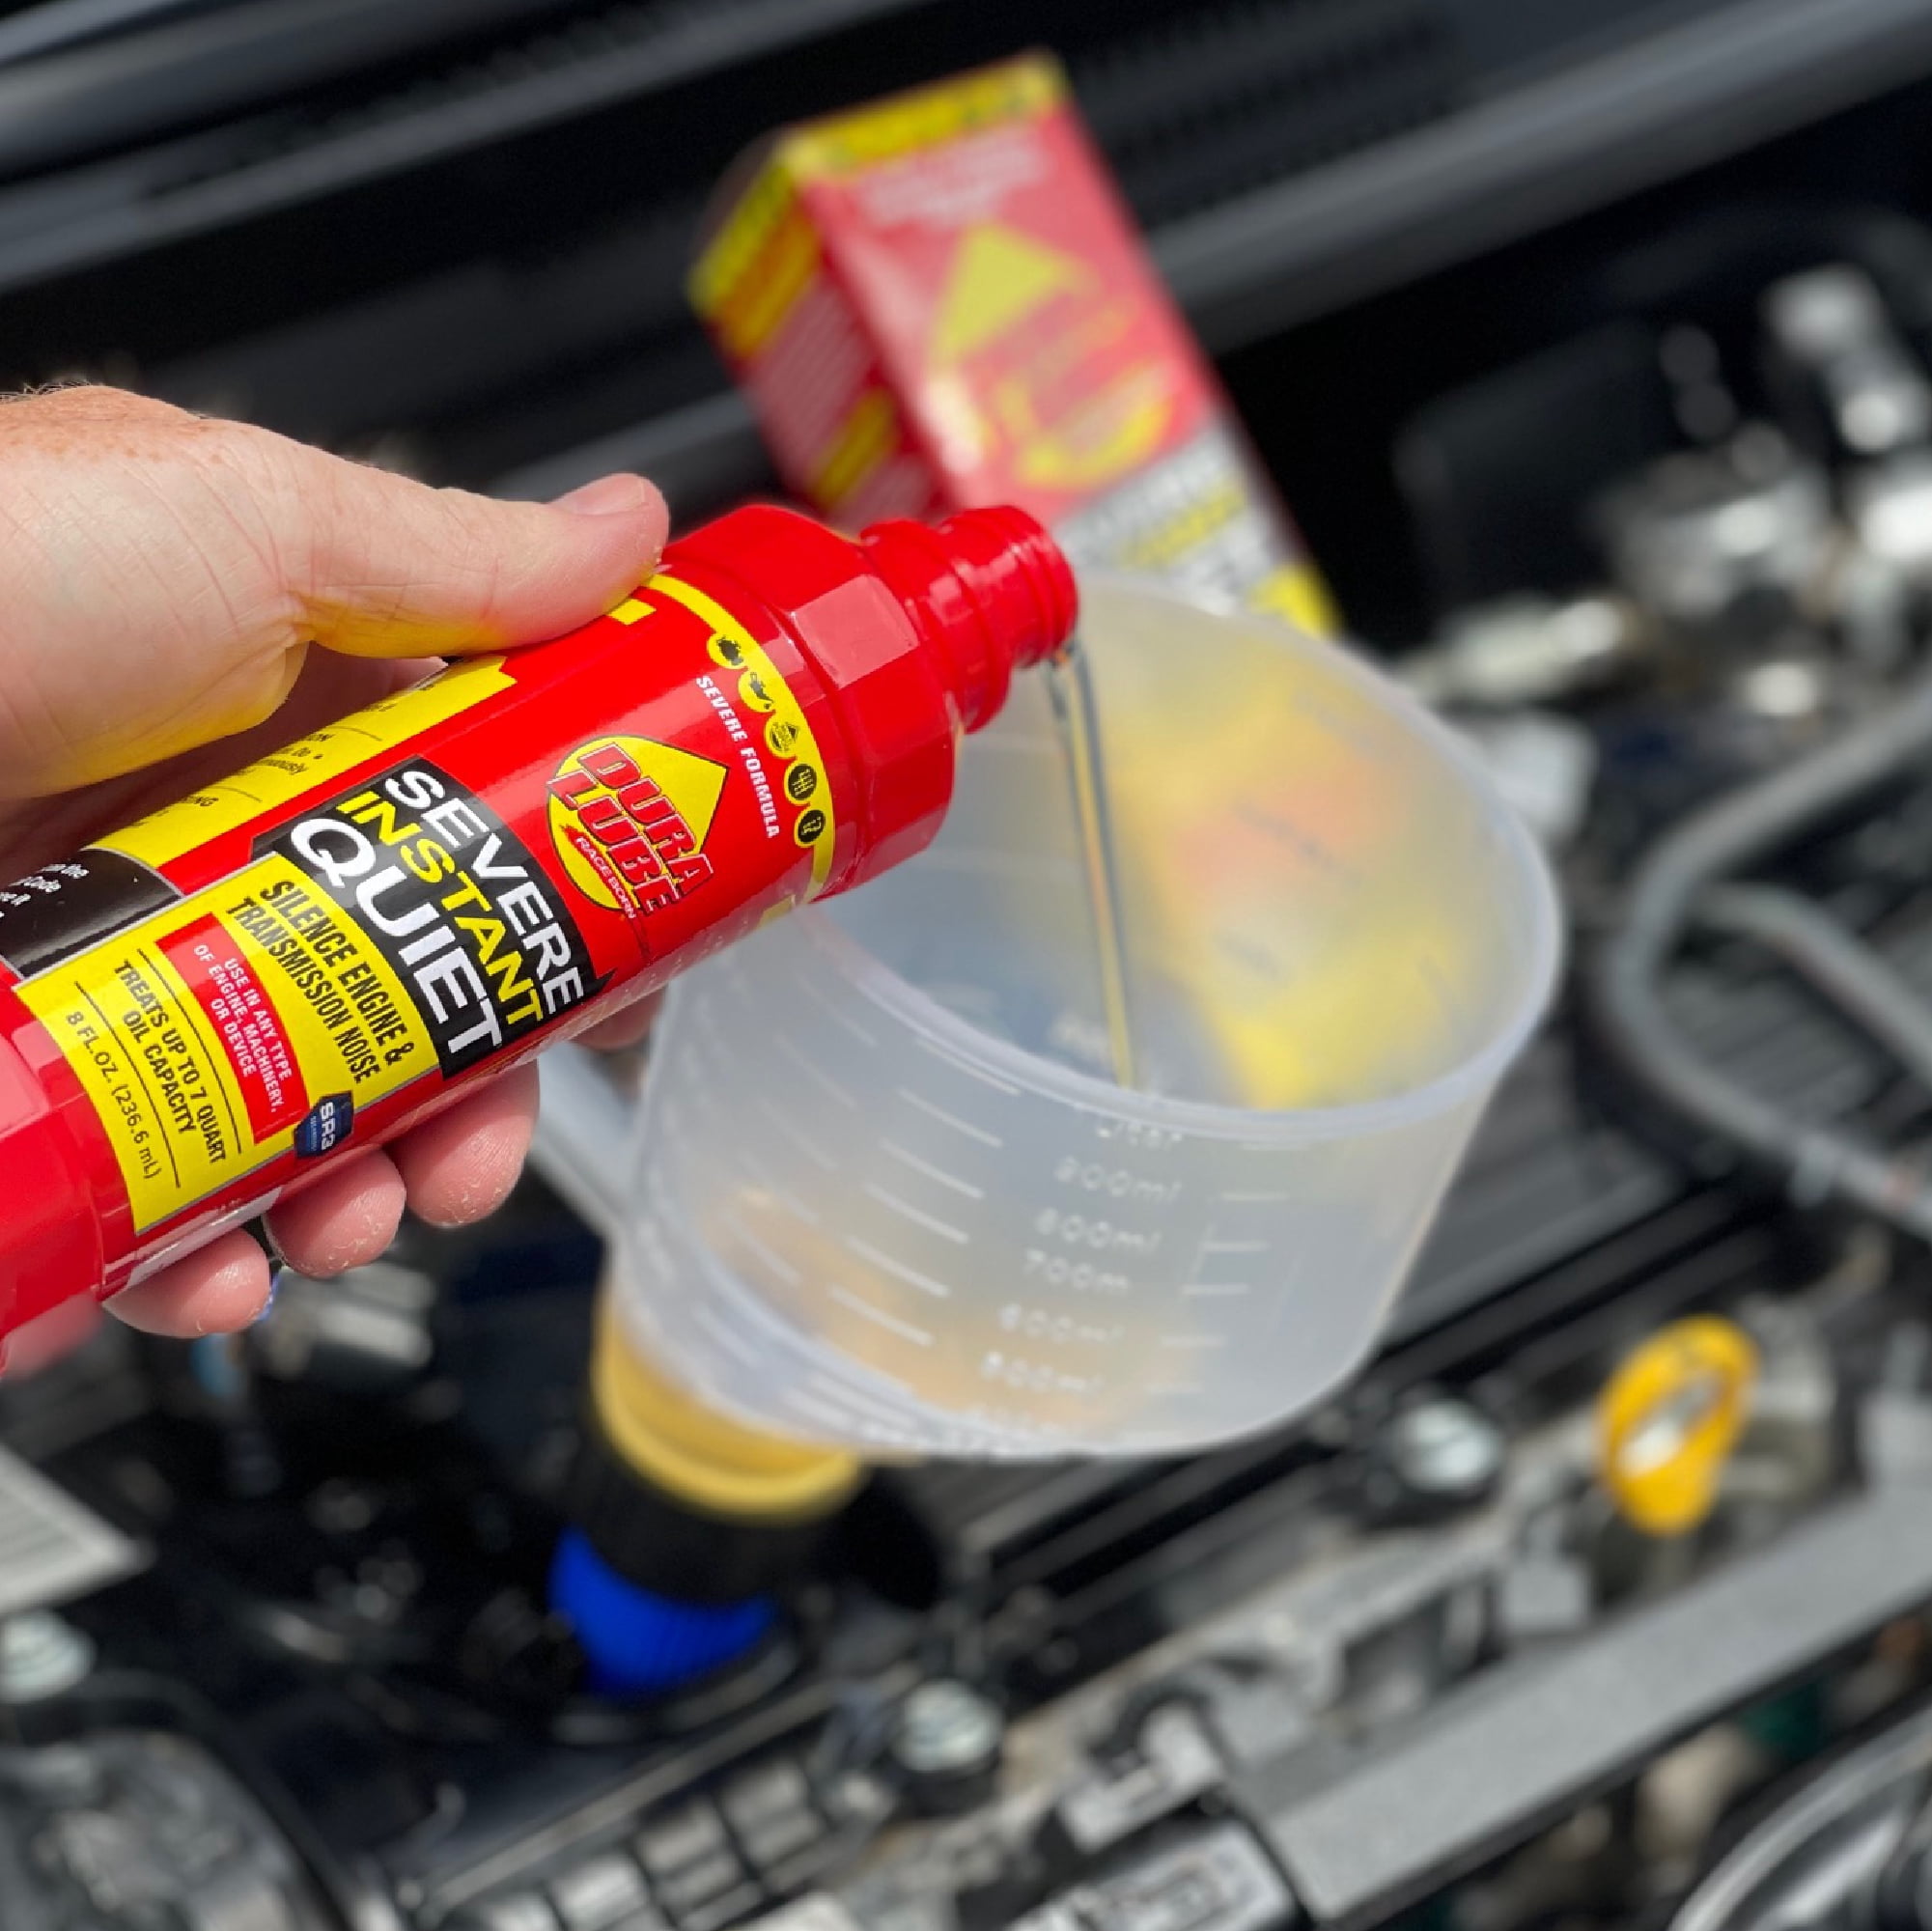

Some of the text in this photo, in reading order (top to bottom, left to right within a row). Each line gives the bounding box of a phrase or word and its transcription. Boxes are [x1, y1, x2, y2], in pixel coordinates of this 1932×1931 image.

[577, 742, 714, 895] DURA
[695, 675, 781, 839] SEVERE FORMULA
[336, 791, 544, 1025] INSTANT
[385, 770, 584, 1015] SEVERE
[546, 769, 682, 916] LUBE
[575, 836, 637, 918] RACE BORN
[194, 943, 215, 963] OF
[208, 964, 245, 1023] ENGINE,
[226, 896, 381, 1084] TRANSMISSION NOISE
[260, 881, 415, 1067] SILENCE ENGINE &
[291, 818, 503, 1053] QUIET
[66, 1010, 84, 1025] 8
[112, 1083, 149, 1145] (236.6
[138, 1147, 163, 1181] mL)
[114, 960, 227, 1163] TREATS UP TO 7 QUART
[122, 1010, 195, 1133] OIL CAPACITY
[210, 998, 257, 1078] OR DEVICE
[224, 958, 293, 1081] USE IN ANY TYPE
